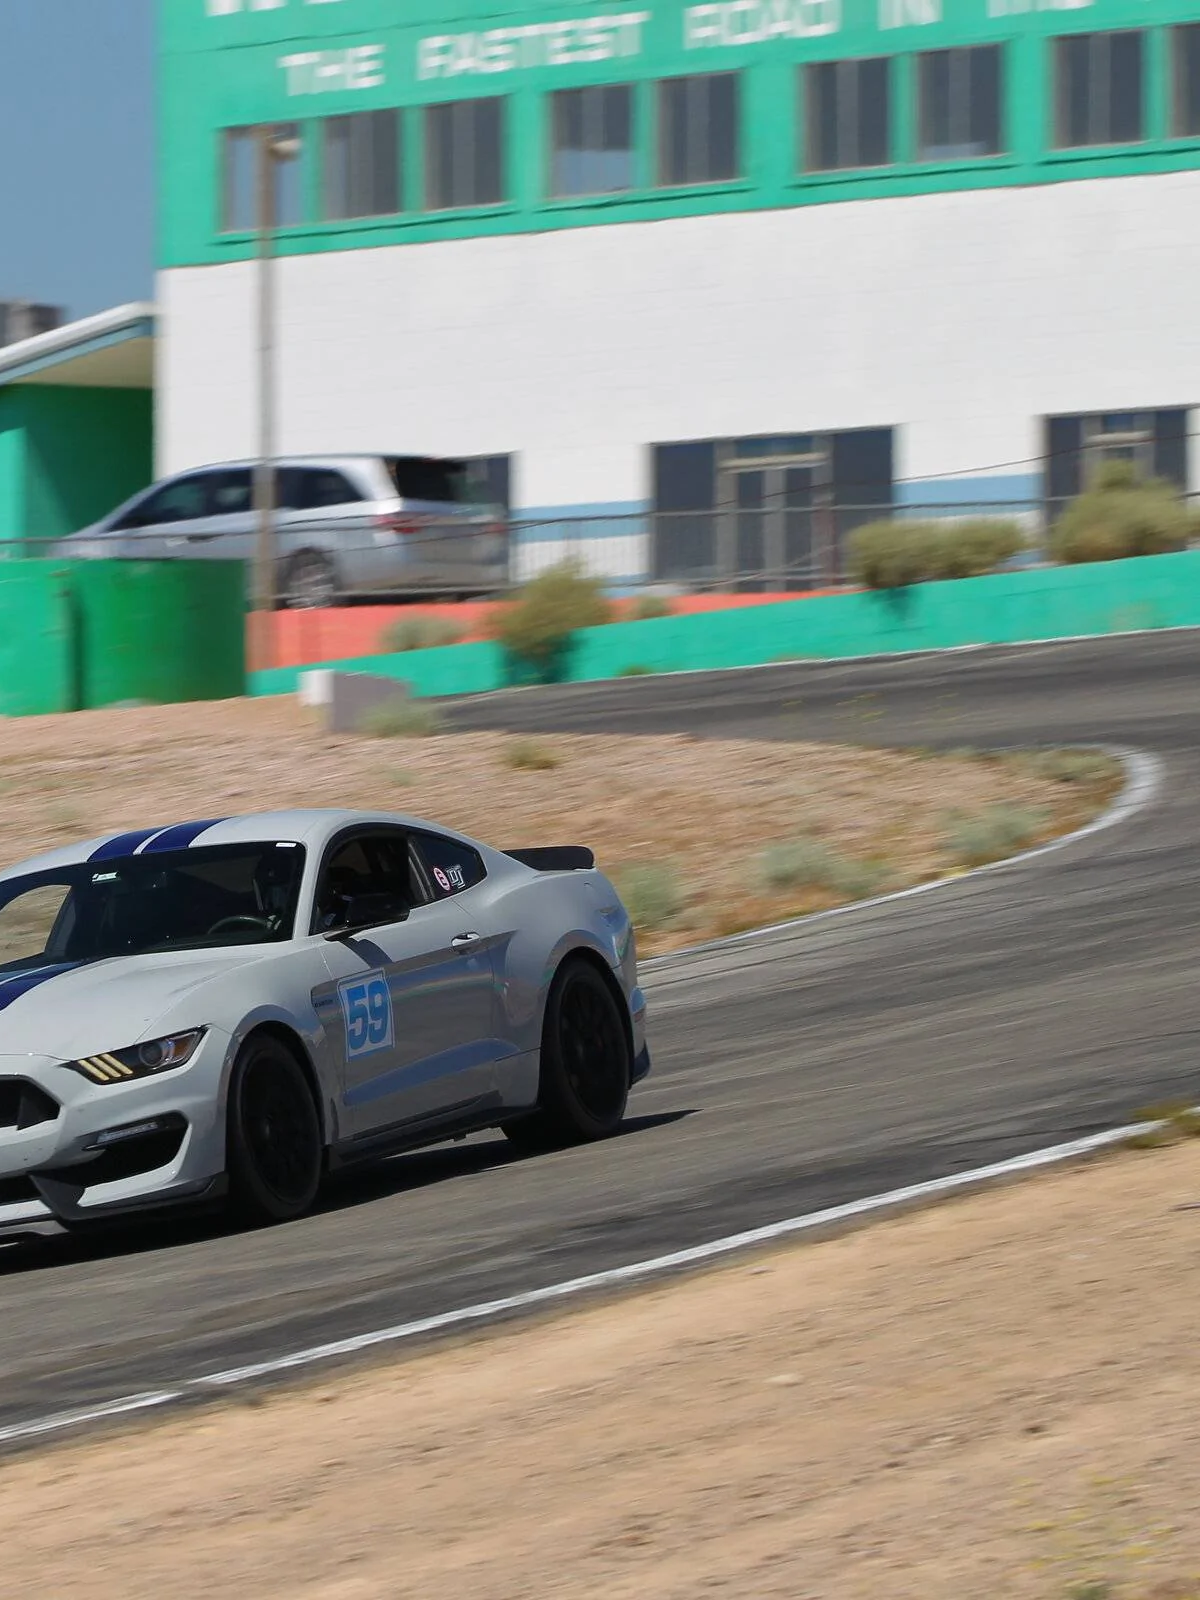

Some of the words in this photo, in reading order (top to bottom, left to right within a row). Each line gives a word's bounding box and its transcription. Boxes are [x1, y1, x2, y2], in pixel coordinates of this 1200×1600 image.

[277, 44, 386, 96] THE
[415, 11, 652, 81] FASTEST
[683, 0, 841, 50] ROAD
[346, 979, 389, 1051] 59
